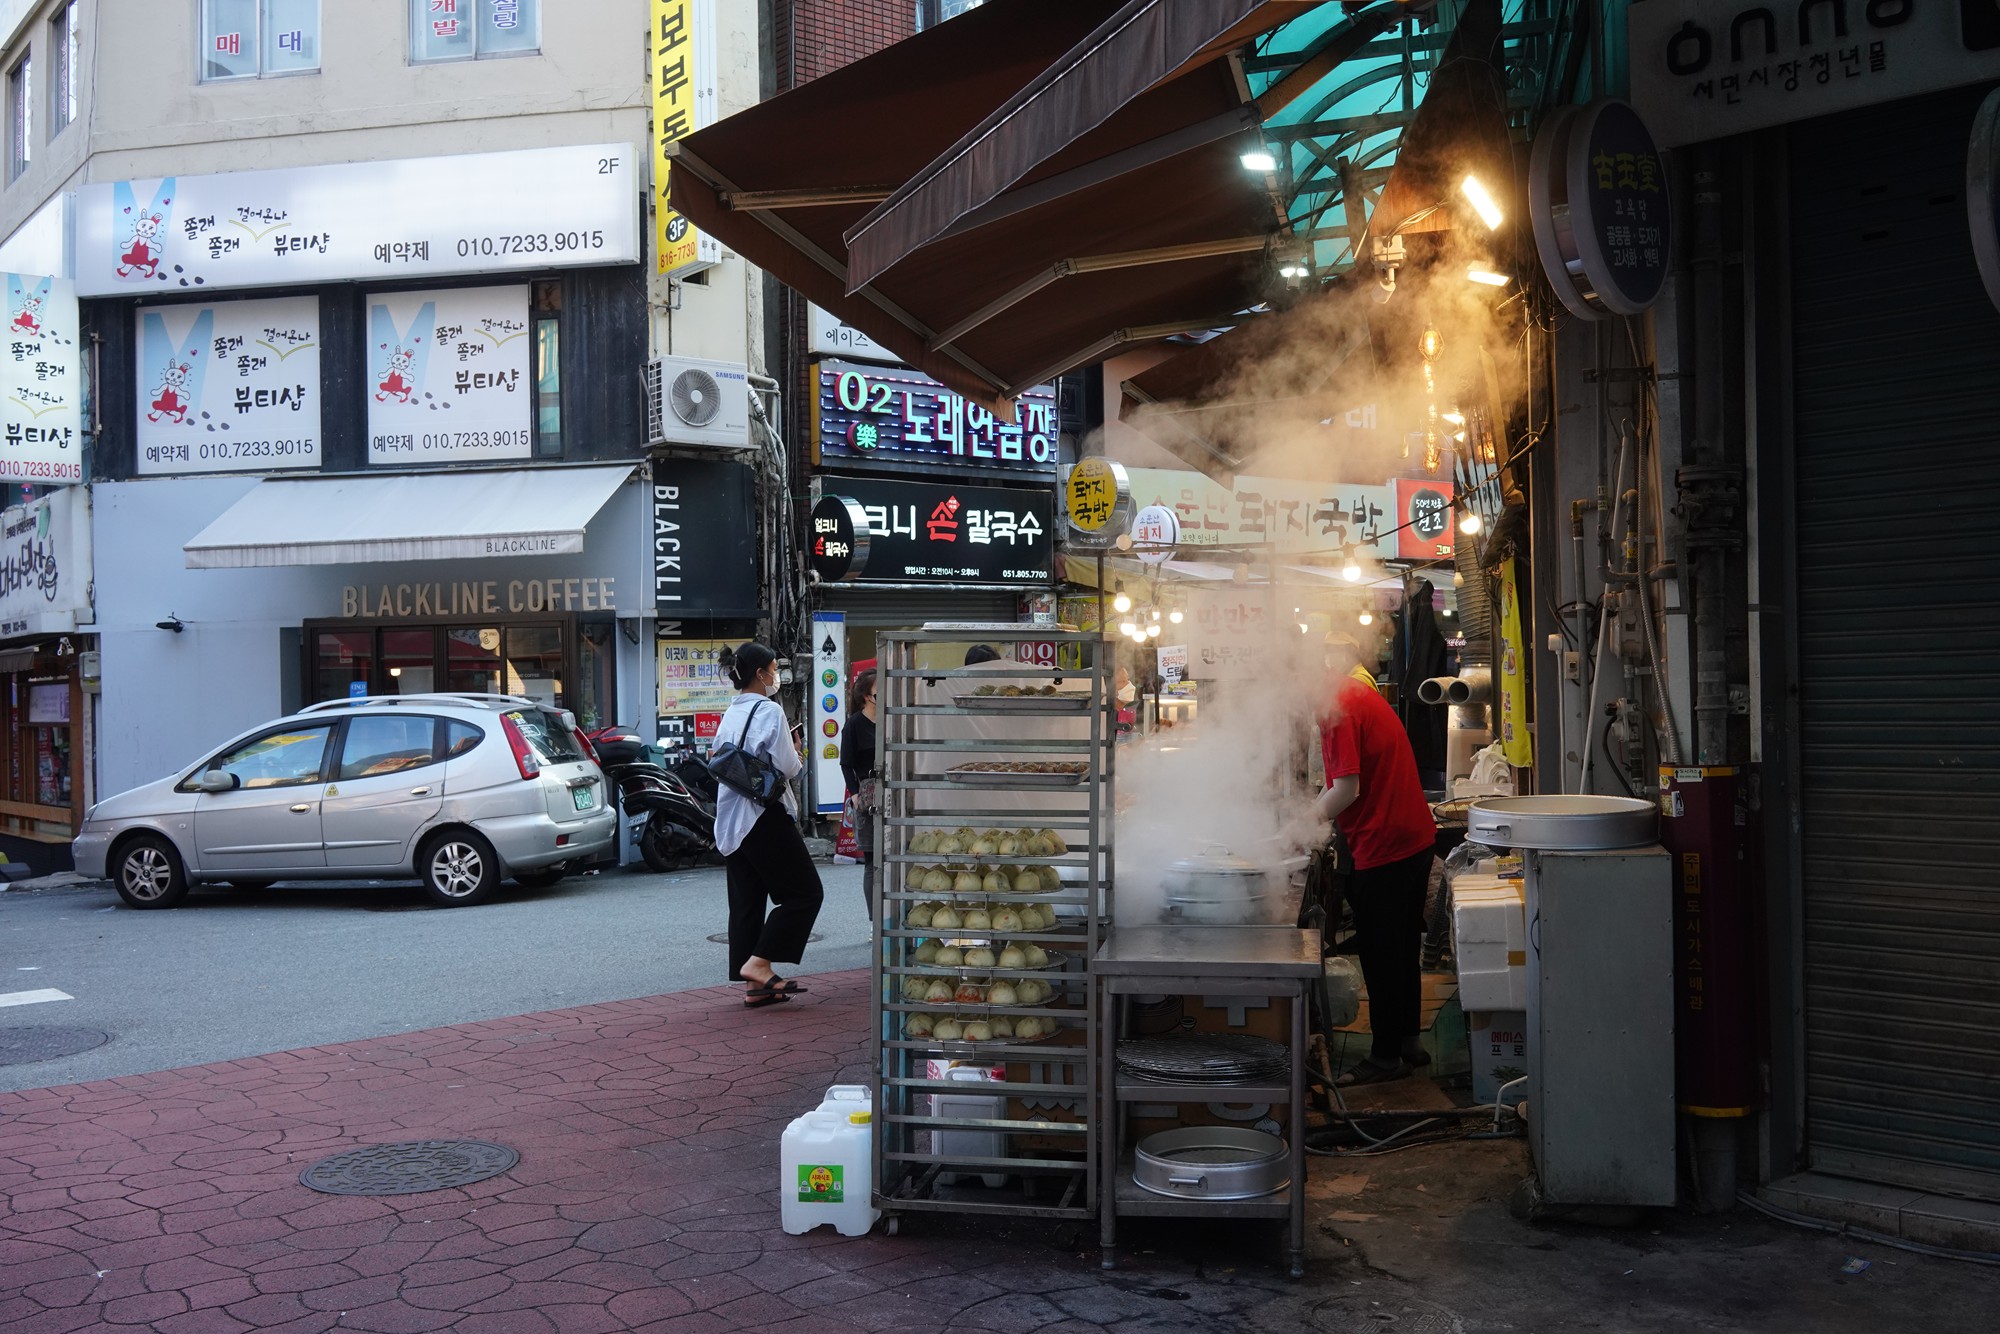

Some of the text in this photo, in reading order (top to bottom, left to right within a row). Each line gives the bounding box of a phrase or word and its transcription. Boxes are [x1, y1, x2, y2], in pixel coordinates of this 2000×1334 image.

[215, 32, 240, 54] 매
[278, 30, 301, 52] 대
[598, 158, 619, 174] 2F
[237, 206, 288, 224] 걸어온나
[1615, 198, 1647, 220] 고옥당
[184, 215, 215, 240] 쫄래
[668, 217, 686, 239] 3F
[208, 236, 240, 259] 쫄래
[273, 232, 330, 257] 뷰티샵
[374, 230, 604, 263] 예약제 010.7233.9015
[659, 241, 696, 269] 816-7730
[263, 328, 311, 345] 걸어온나
[435, 325, 463, 346] 쫄래
[481, 318, 525, 334] 걸어온나
[213, 336, 244, 359] 쫄래
[825, 328, 869, 348] 에이스
[10, 342, 41, 362] 쫄래
[457, 342, 485, 362] 쫄래
[35, 361, 65, 380] 쫄래
[237, 355, 267, 377] 쫄래
[715, 371, 745, 380] SAMSUNG
[454, 368, 520, 395] 뷰티샵
[16, 387, 64, 405] 걸어온나
[234, 384, 306, 414] 뷰티샵
[5, 422, 73, 449] 뷰티샵
[373, 430, 529, 453] 예약제 010.7233.9015
[146, 439, 314, 463] 예약제 010.7233.9015
[0, 460, 81, 479] 010.7233.9015
[1073, 479, 1106, 500] 돼지
[1074, 498, 1109, 524] 국밥
[814, 517, 838, 533] 얼크니
[926, 501, 959, 543] 손
[966, 509, 1043, 546] 칼국수
[486, 538, 557, 554] BLACKLINE
[825, 541, 850, 557] 칼국수
[904, 566, 926, 575] 영업시간
[1002, 570, 1048, 579] 051.805.7700
[342, 576, 616, 618] BLACKLINE COFFEE
[665, 647, 689, 660] 이곳에
[666, 664, 696, 678] 쓰레기를
[700, 720, 718, 729] 에스원
[575, 793, 593, 810] 9040
[1684, 854, 1699, 889] 주의
[1685, 900, 1704, 1011] 도시가스배관
[1490, 1031, 1524, 1043] 에이스
